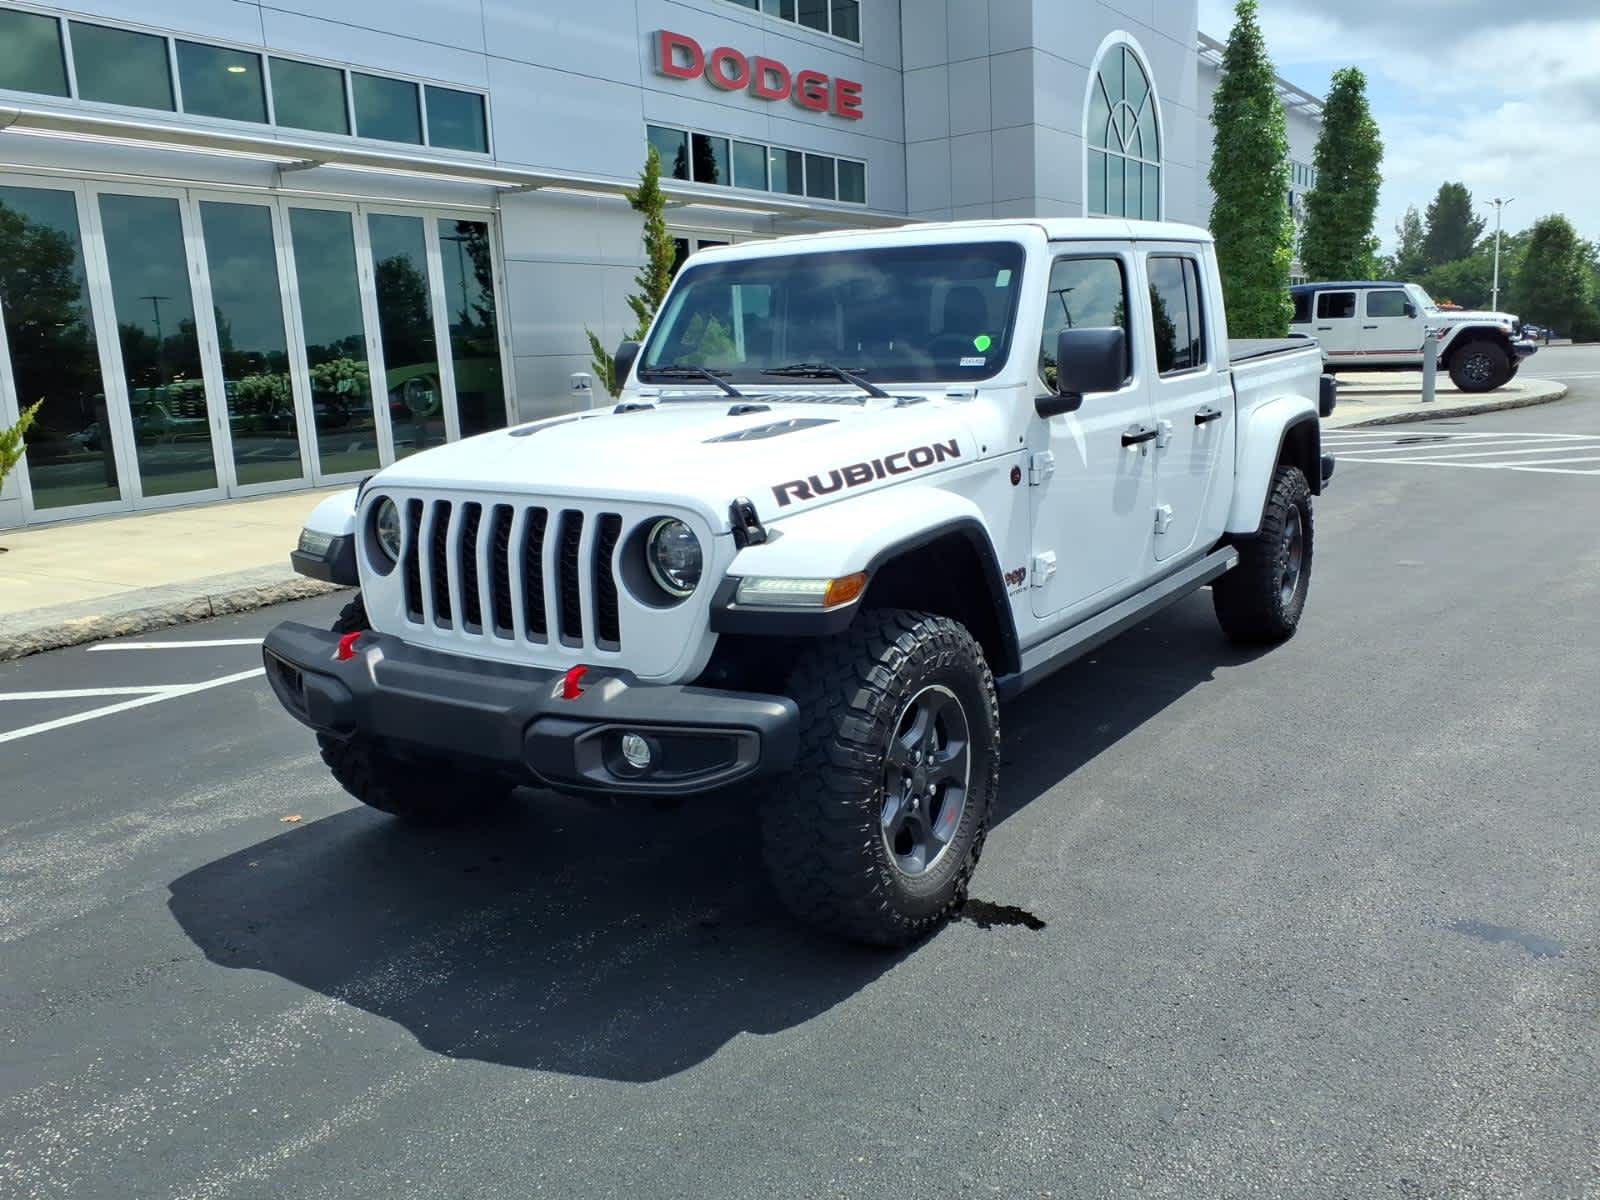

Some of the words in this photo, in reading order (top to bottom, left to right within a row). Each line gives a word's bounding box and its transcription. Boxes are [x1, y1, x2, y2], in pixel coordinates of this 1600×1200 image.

[654, 29, 864, 120] DODGE
[771, 439, 961, 507] RUBICON
[1004, 567, 1027, 586] eep
